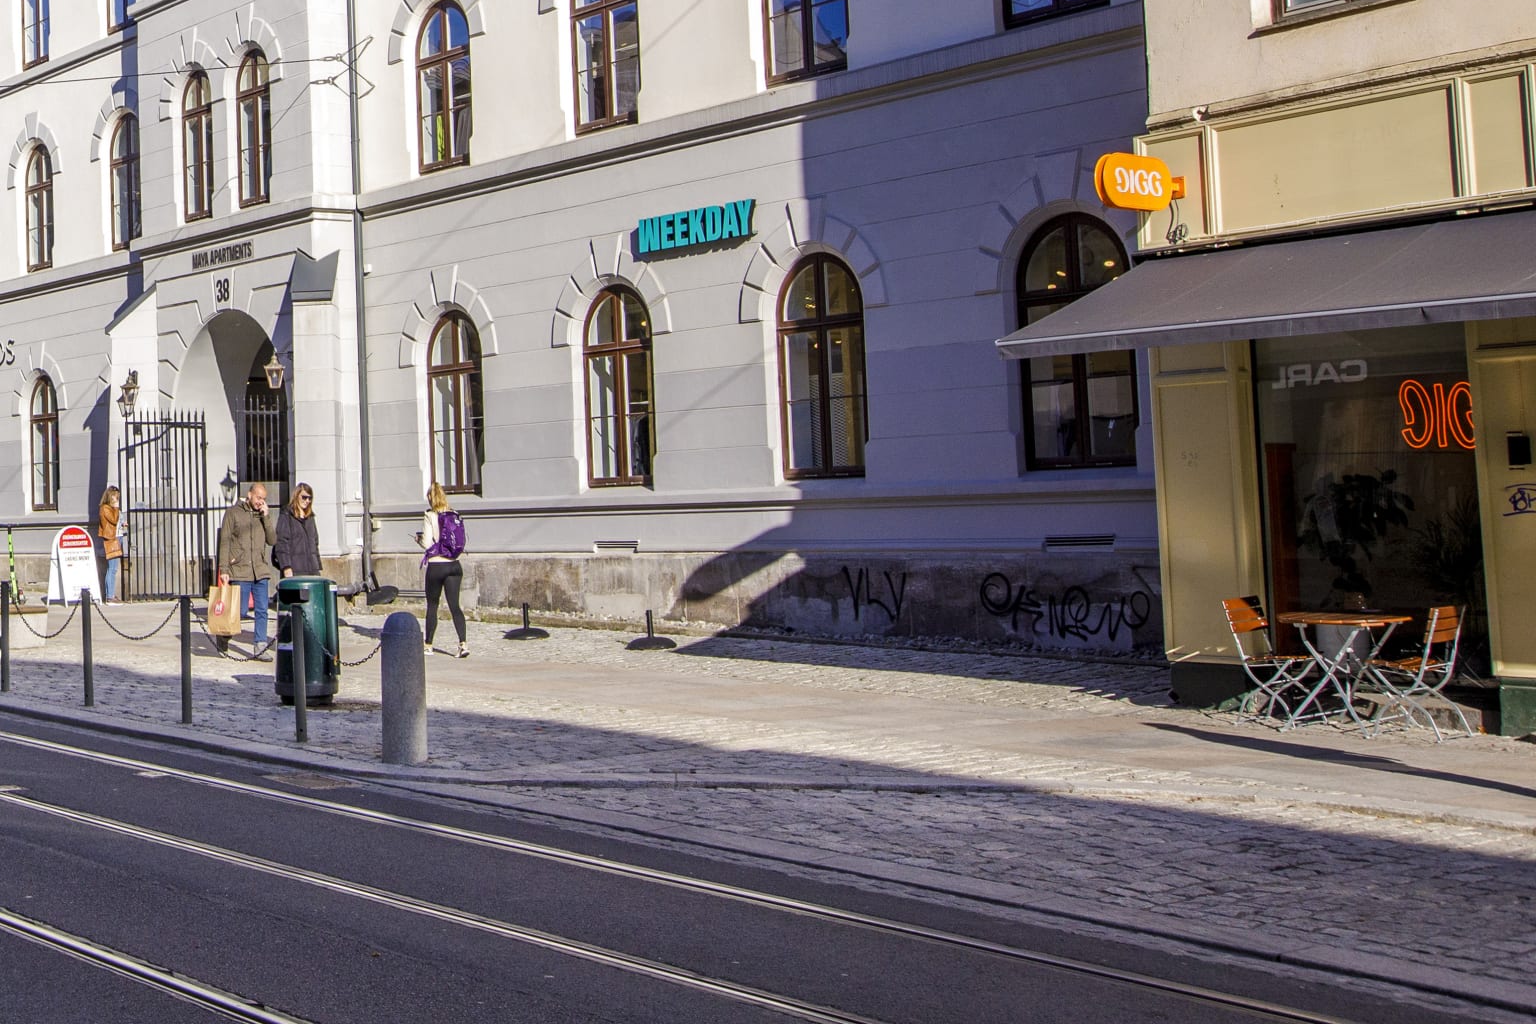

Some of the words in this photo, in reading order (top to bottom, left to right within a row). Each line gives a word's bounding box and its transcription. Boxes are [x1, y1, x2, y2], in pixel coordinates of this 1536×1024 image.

[1114, 167, 1164, 197] DIGG
[638, 198, 753, 254] WEEKDAY
[192, 251, 210, 270] MAYA
[210, 241, 253, 267] APARTMENTS
[215, 277, 230, 303] 38
